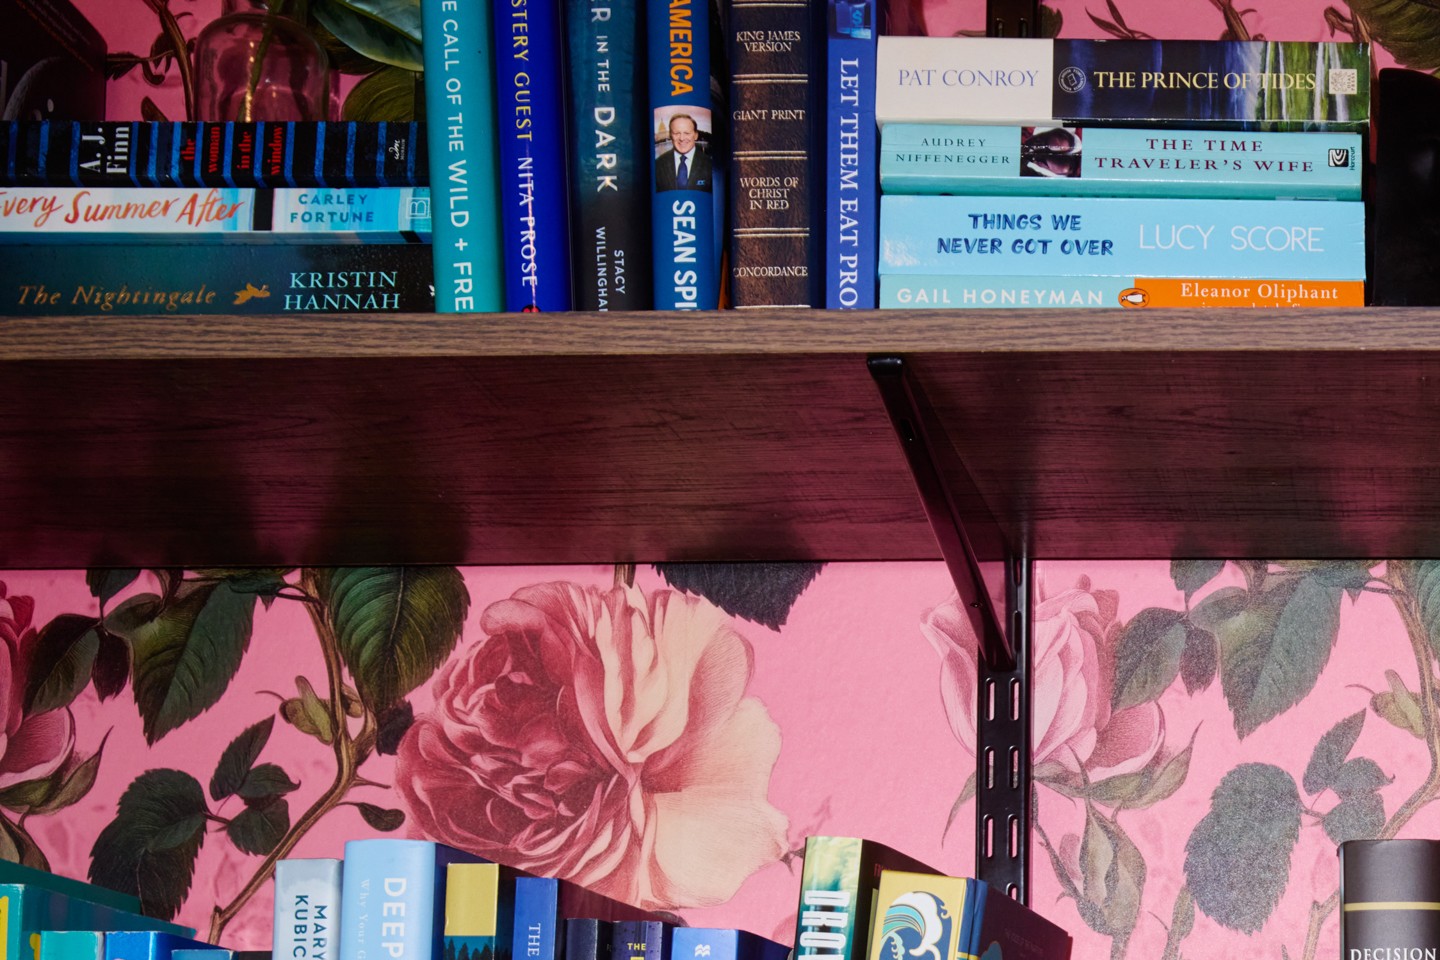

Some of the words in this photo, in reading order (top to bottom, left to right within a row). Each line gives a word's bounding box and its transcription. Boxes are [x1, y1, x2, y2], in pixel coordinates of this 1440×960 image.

[442, 19, 460, 71] CALL
[736, 30, 765, 42] KING
[768, 30, 800, 42] JAMES
[744, 41, 792, 53] VERSION
[840, 58, 859, 107] LET
[898, 68, 936, 87] PAT
[941, 69, 1040, 88] CONROY
[1093, 71, 1138, 89] THE
[1141, 71, 1219, 90] PRINCE
[1223, 71, 1252, 90] OF
[1260, 71, 1317, 91] TIDES
[446, 78, 461, 105] OF
[514, 72, 532, 142] GUEST
[733, 109, 767, 121] GIANT
[771, 109, 805, 120] PRINT
[448, 113, 464, 151] THE
[208, 126, 220, 173] woman
[271, 124, 284, 176] window
[595, 106, 618, 193] DARK
[840, 113, 859, 190] THEM
[921, 137, 987, 148] AUDREY
[1146, 138, 1194, 151] THE
[1203, 139, 1263, 152] TIME
[895, 153, 1011, 165] NIFFENEGGER
[1095, 157, 1243, 171] TRAVELER'S
[1254, 158, 1314, 173] WIFE
[740, 177, 779, 188] WORDS
[783, 177, 799, 188] OF
[299, 194, 368, 206] CARLEY
[449, 160, 469, 228] WILD
[748, 188, 790, 200] CHRIST
[64, 192, 180, 223] Summer
[175, 188, 245, 227] After
[750, 199, 762, 210] IN
[765, 199, 789, 210] RED
[290, 211, 374, 223] FORTUNE
[840, 198, 858, 247] EAT
[968, 213, 1045, 231] THINGS
[1052, 215, 1082, 231] WE
[673, 200, 696, 263] SEAN
[1139, 224, 1214, 251] LUCY
[1230, 225, 1325, 252] SCORE
[937, 237, 1002, 255] NEVER
[1011, 238, 1050, 256] GOT
[1060, 239, 1114, 257] OVER
[289, 271, 398, 289] KRISTIN
[614, 250, 625, 295] STACY
[18, 285, 62, 305] The
[71, 286, 217, 311] Nightingale
[284, 293, 400, 310] HANNAH
[897, 289, 954, 304] GAIL
[963, 289, 1103, 306] HONEYMAN
[1181, 282, 1253, 299] Eleanor
[1257, 283, 1338, 301] Oliphant
